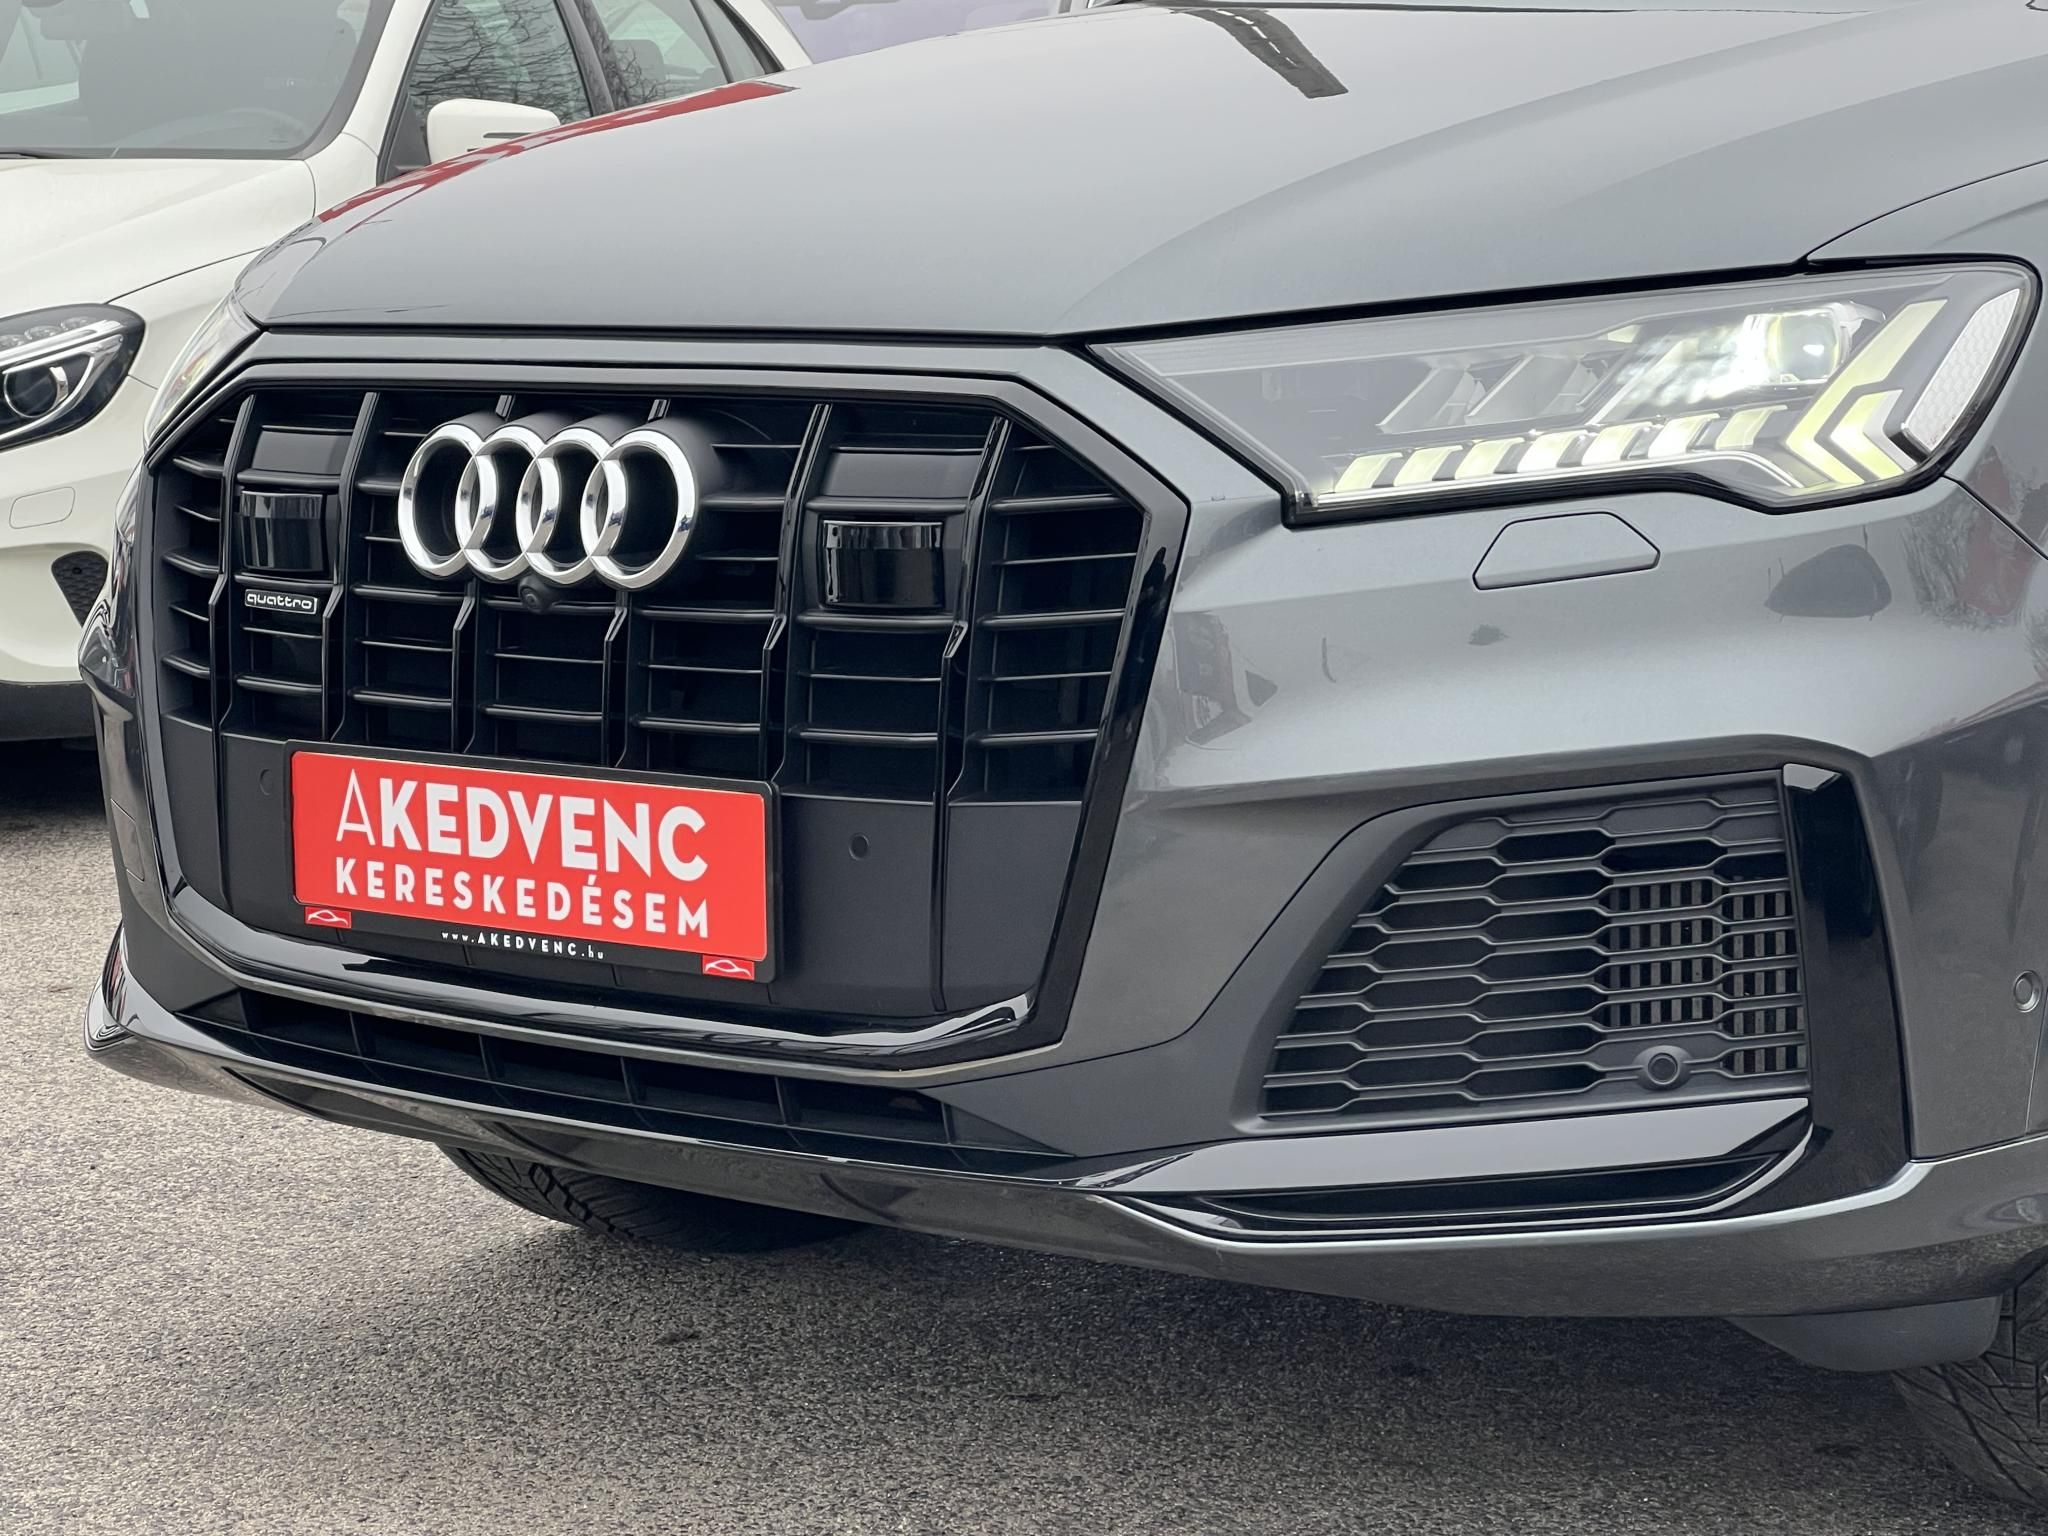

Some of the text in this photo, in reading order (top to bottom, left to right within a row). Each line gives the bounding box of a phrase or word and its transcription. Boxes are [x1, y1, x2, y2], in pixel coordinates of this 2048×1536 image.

[247, 593, 312, 609] quattro
[336, 768, 708, 882] AKEDVENC
[336, 856, 709, 939] KERESKEDÉSEM
[441, 930, 605, 960] www.AKEDVENC.hu
